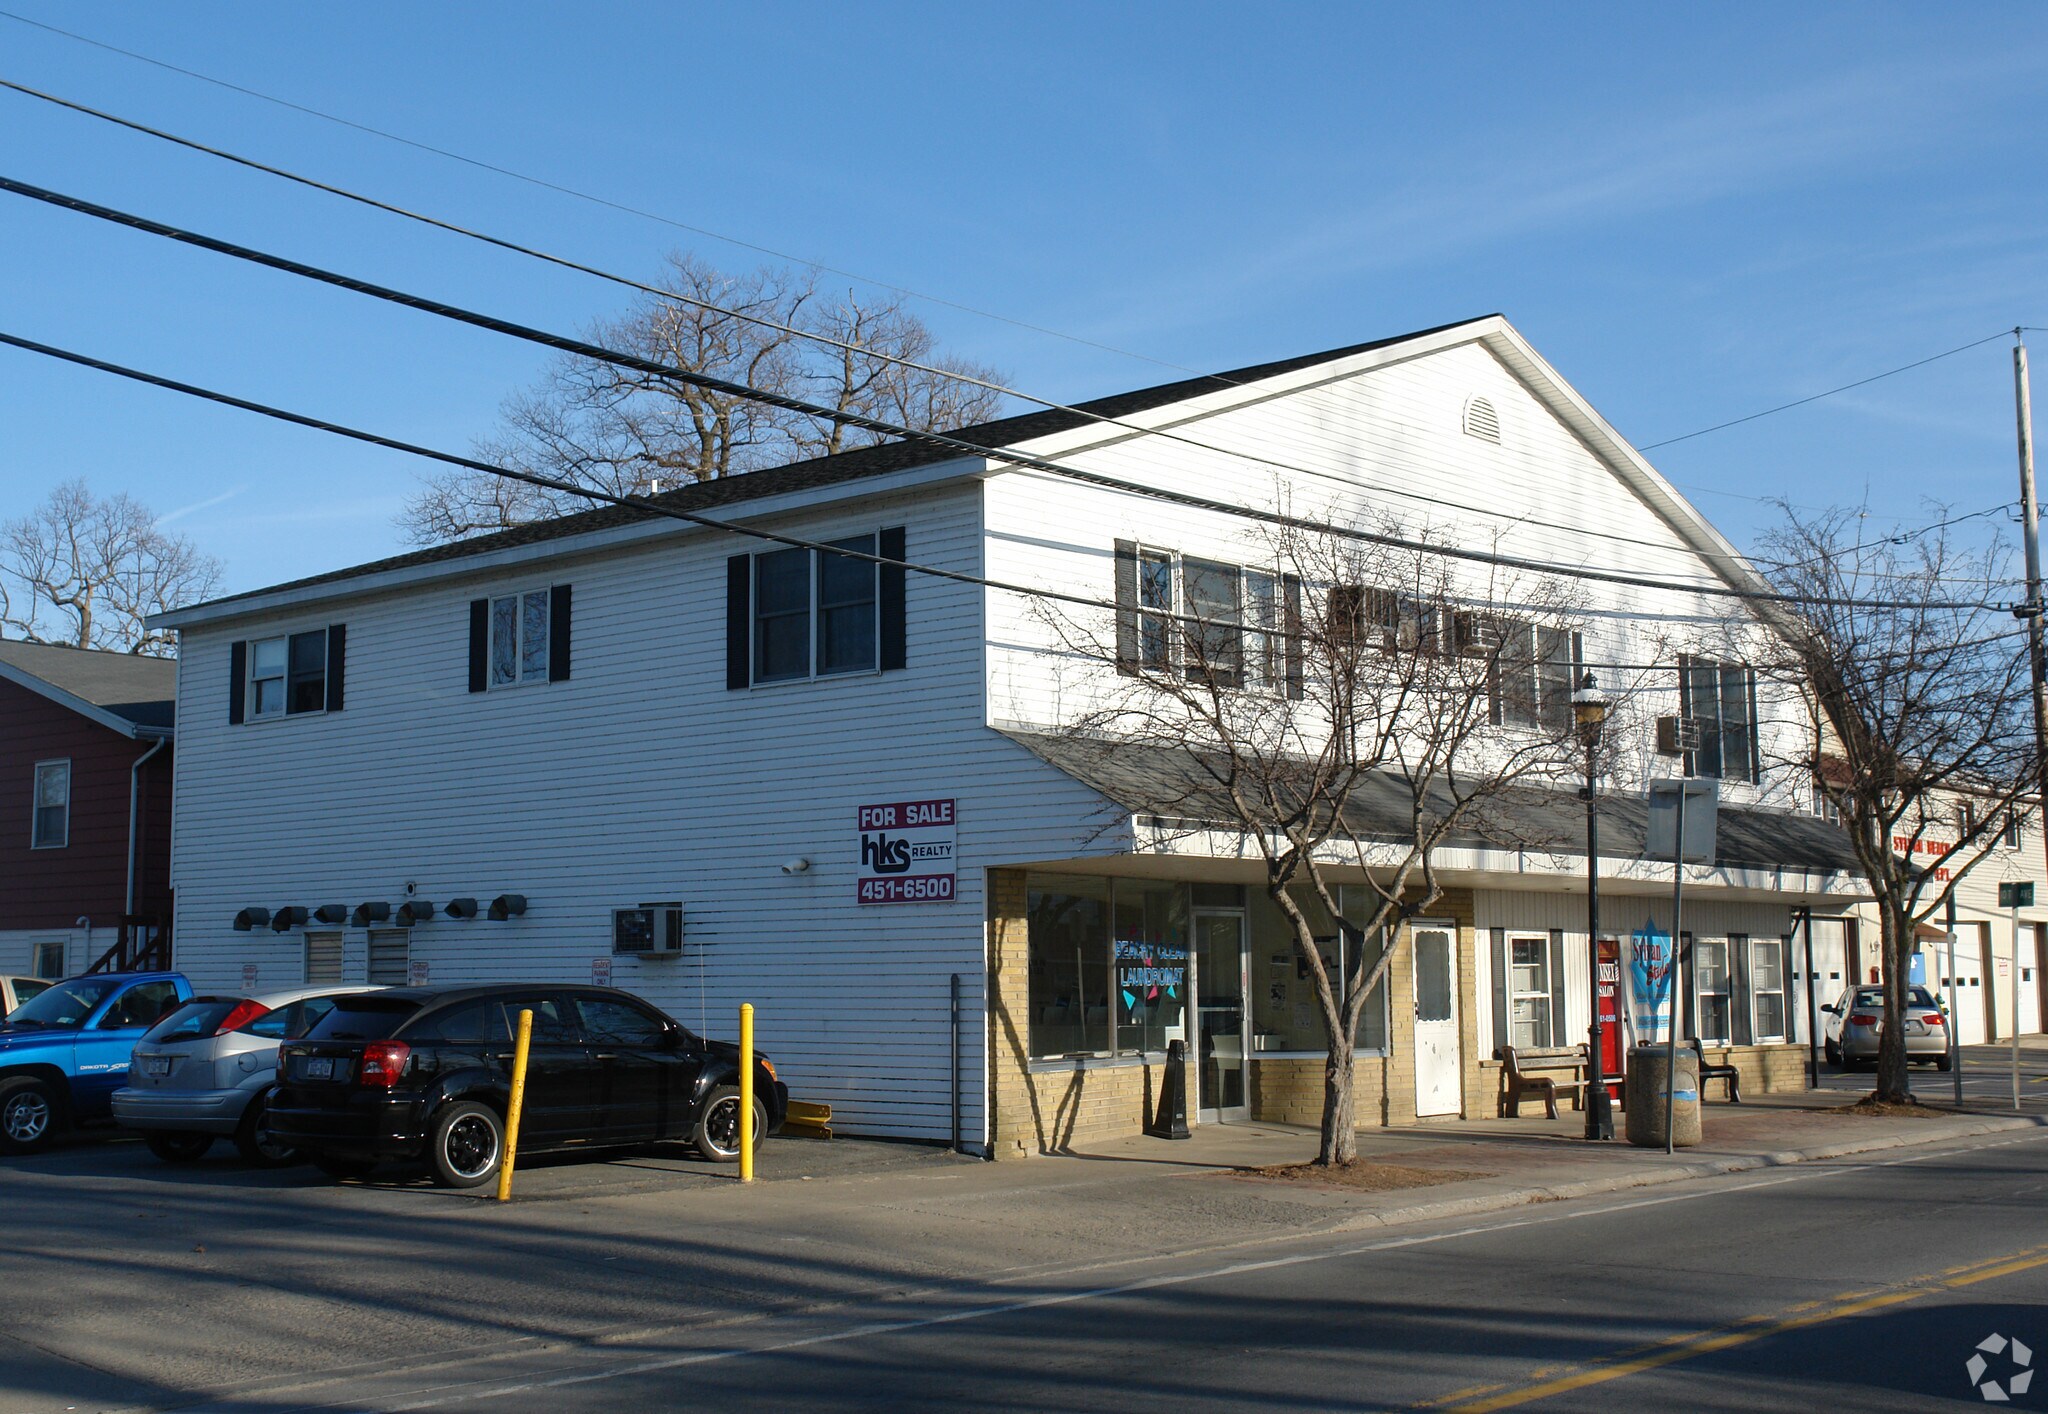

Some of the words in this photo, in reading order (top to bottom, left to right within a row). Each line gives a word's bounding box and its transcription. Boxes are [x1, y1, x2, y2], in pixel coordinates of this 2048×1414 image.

[861, 807, 896, 828] FOR
[906, 802, 952, 825] SALE
[861, 832, 911, 874] hks
[911, 845, 952, 857] REALTY
[861, 877, 951, 900] 451-6500
[1632, 937, 1661, 967] Sylvan
[1120, 967, 1185, 987] LAUNDROMAT
[1599, 963, 1615, 981] NISEX
[80, 1063, 108, 1071] DAKOTA
